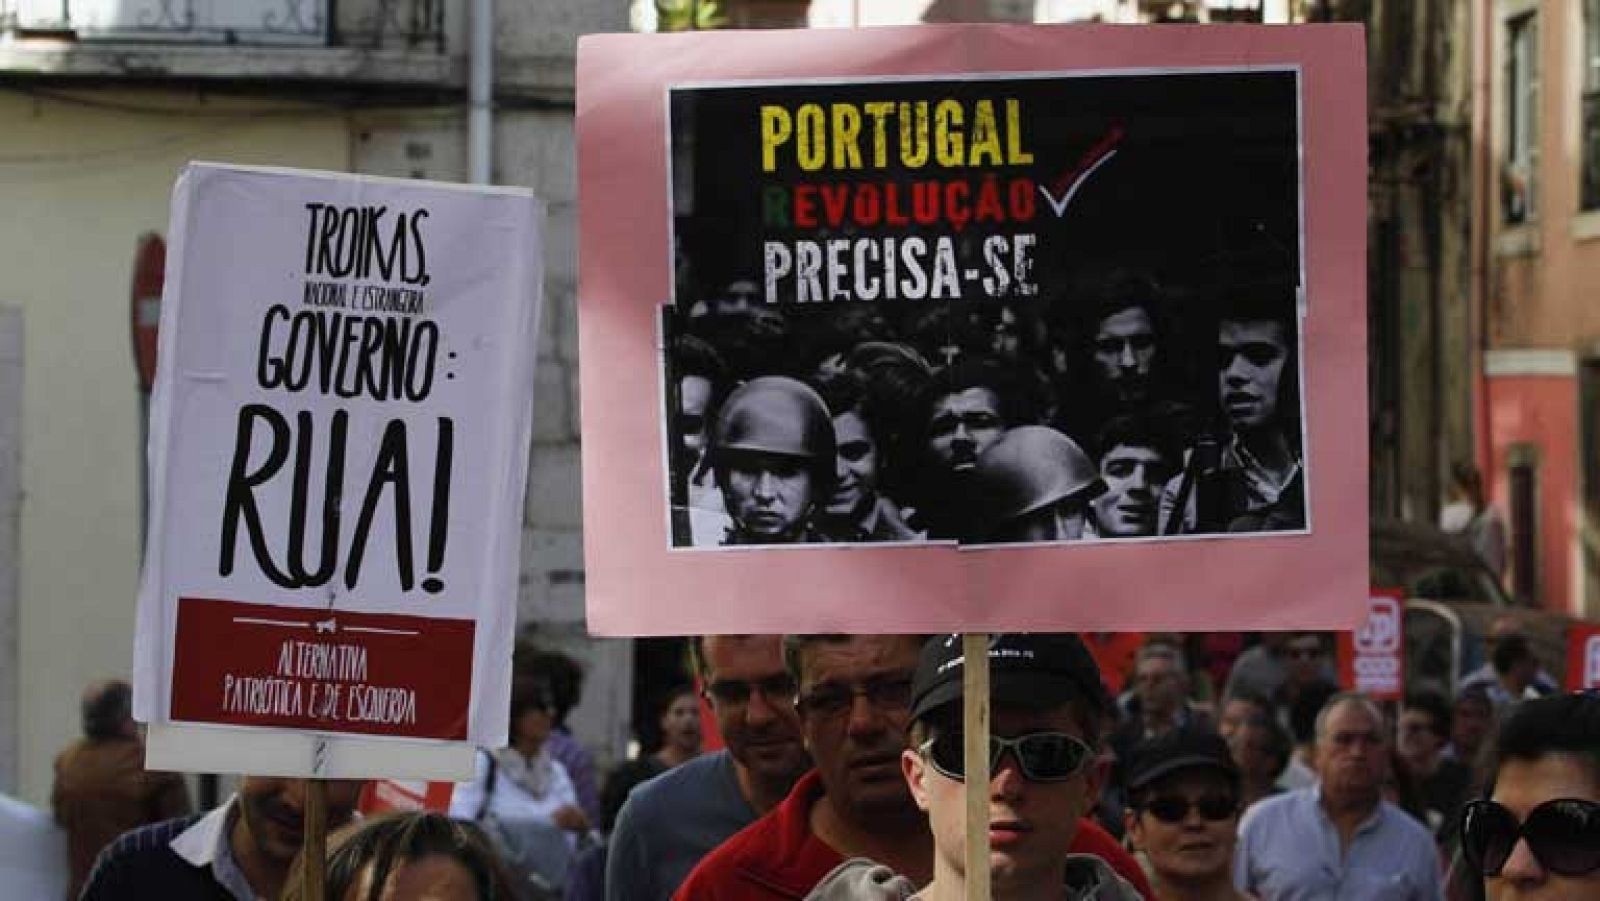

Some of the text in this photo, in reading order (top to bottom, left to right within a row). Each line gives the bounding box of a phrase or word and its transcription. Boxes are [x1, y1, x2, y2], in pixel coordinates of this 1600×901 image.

[760, 98, 1034, 172] PORTUGAL
[764, 234, 1038, 303] PRECISA-SE
[219, 404, 453, 594] RUA!
[277, 640, 367, 681] ALTERNATIVA
[308, 684, 318, 718] E
[323, 684, 342, 720] DE
[348, 684, 416, 725] ESQUERDA
